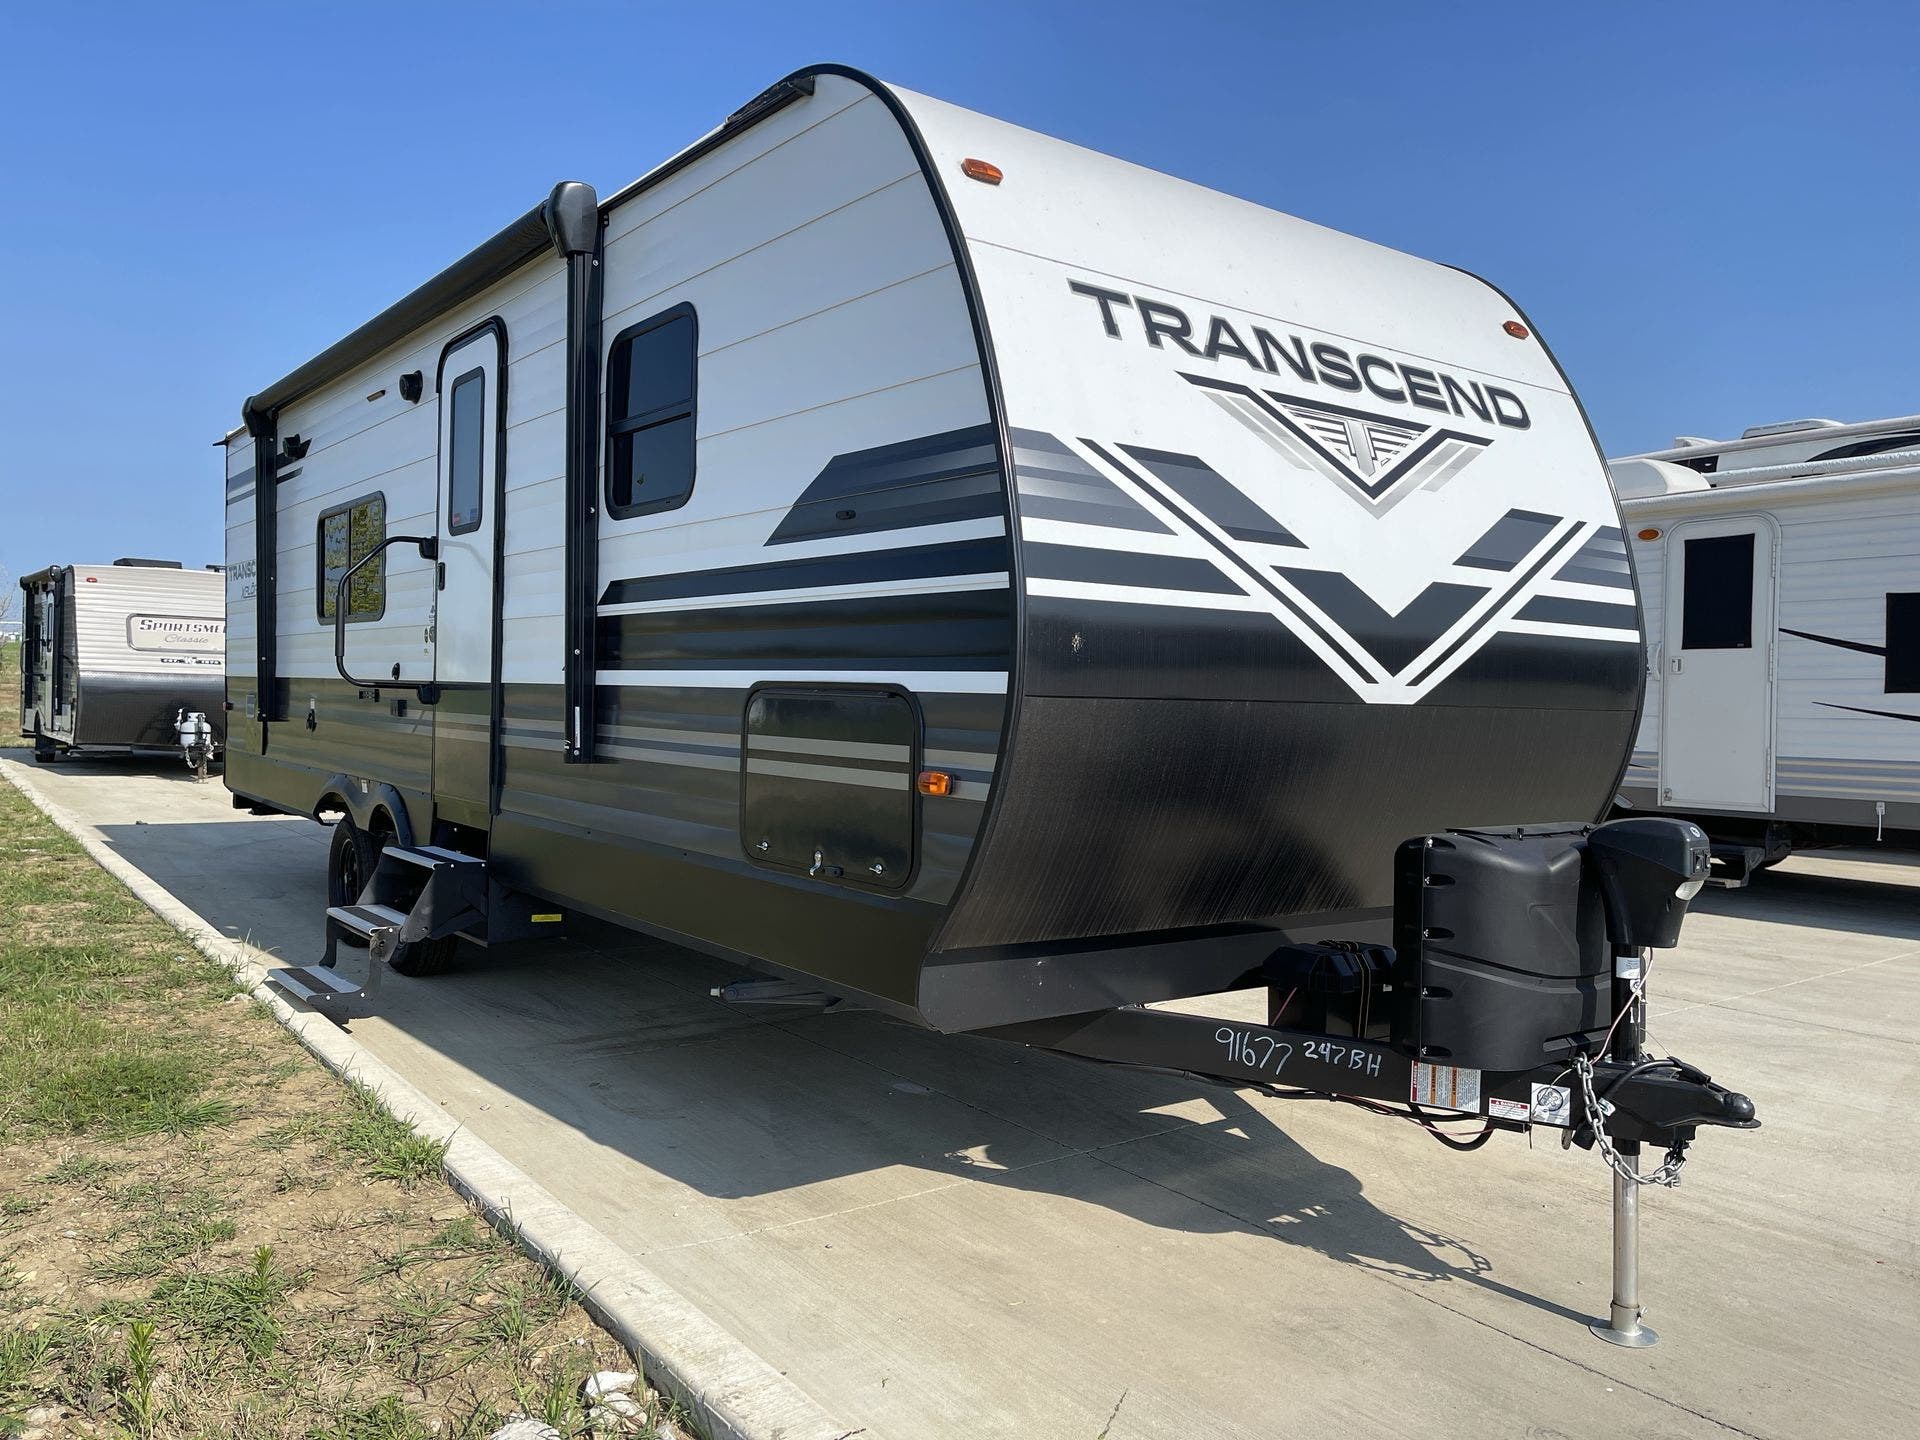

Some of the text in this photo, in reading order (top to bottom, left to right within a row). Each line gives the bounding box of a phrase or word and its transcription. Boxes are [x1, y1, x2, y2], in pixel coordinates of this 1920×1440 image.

[1066, 277, 1532, 431] TRANSCEND
[140, 619, 226, 633] SPORTSME
[1215, 1027, 1293, 1075] 91677
